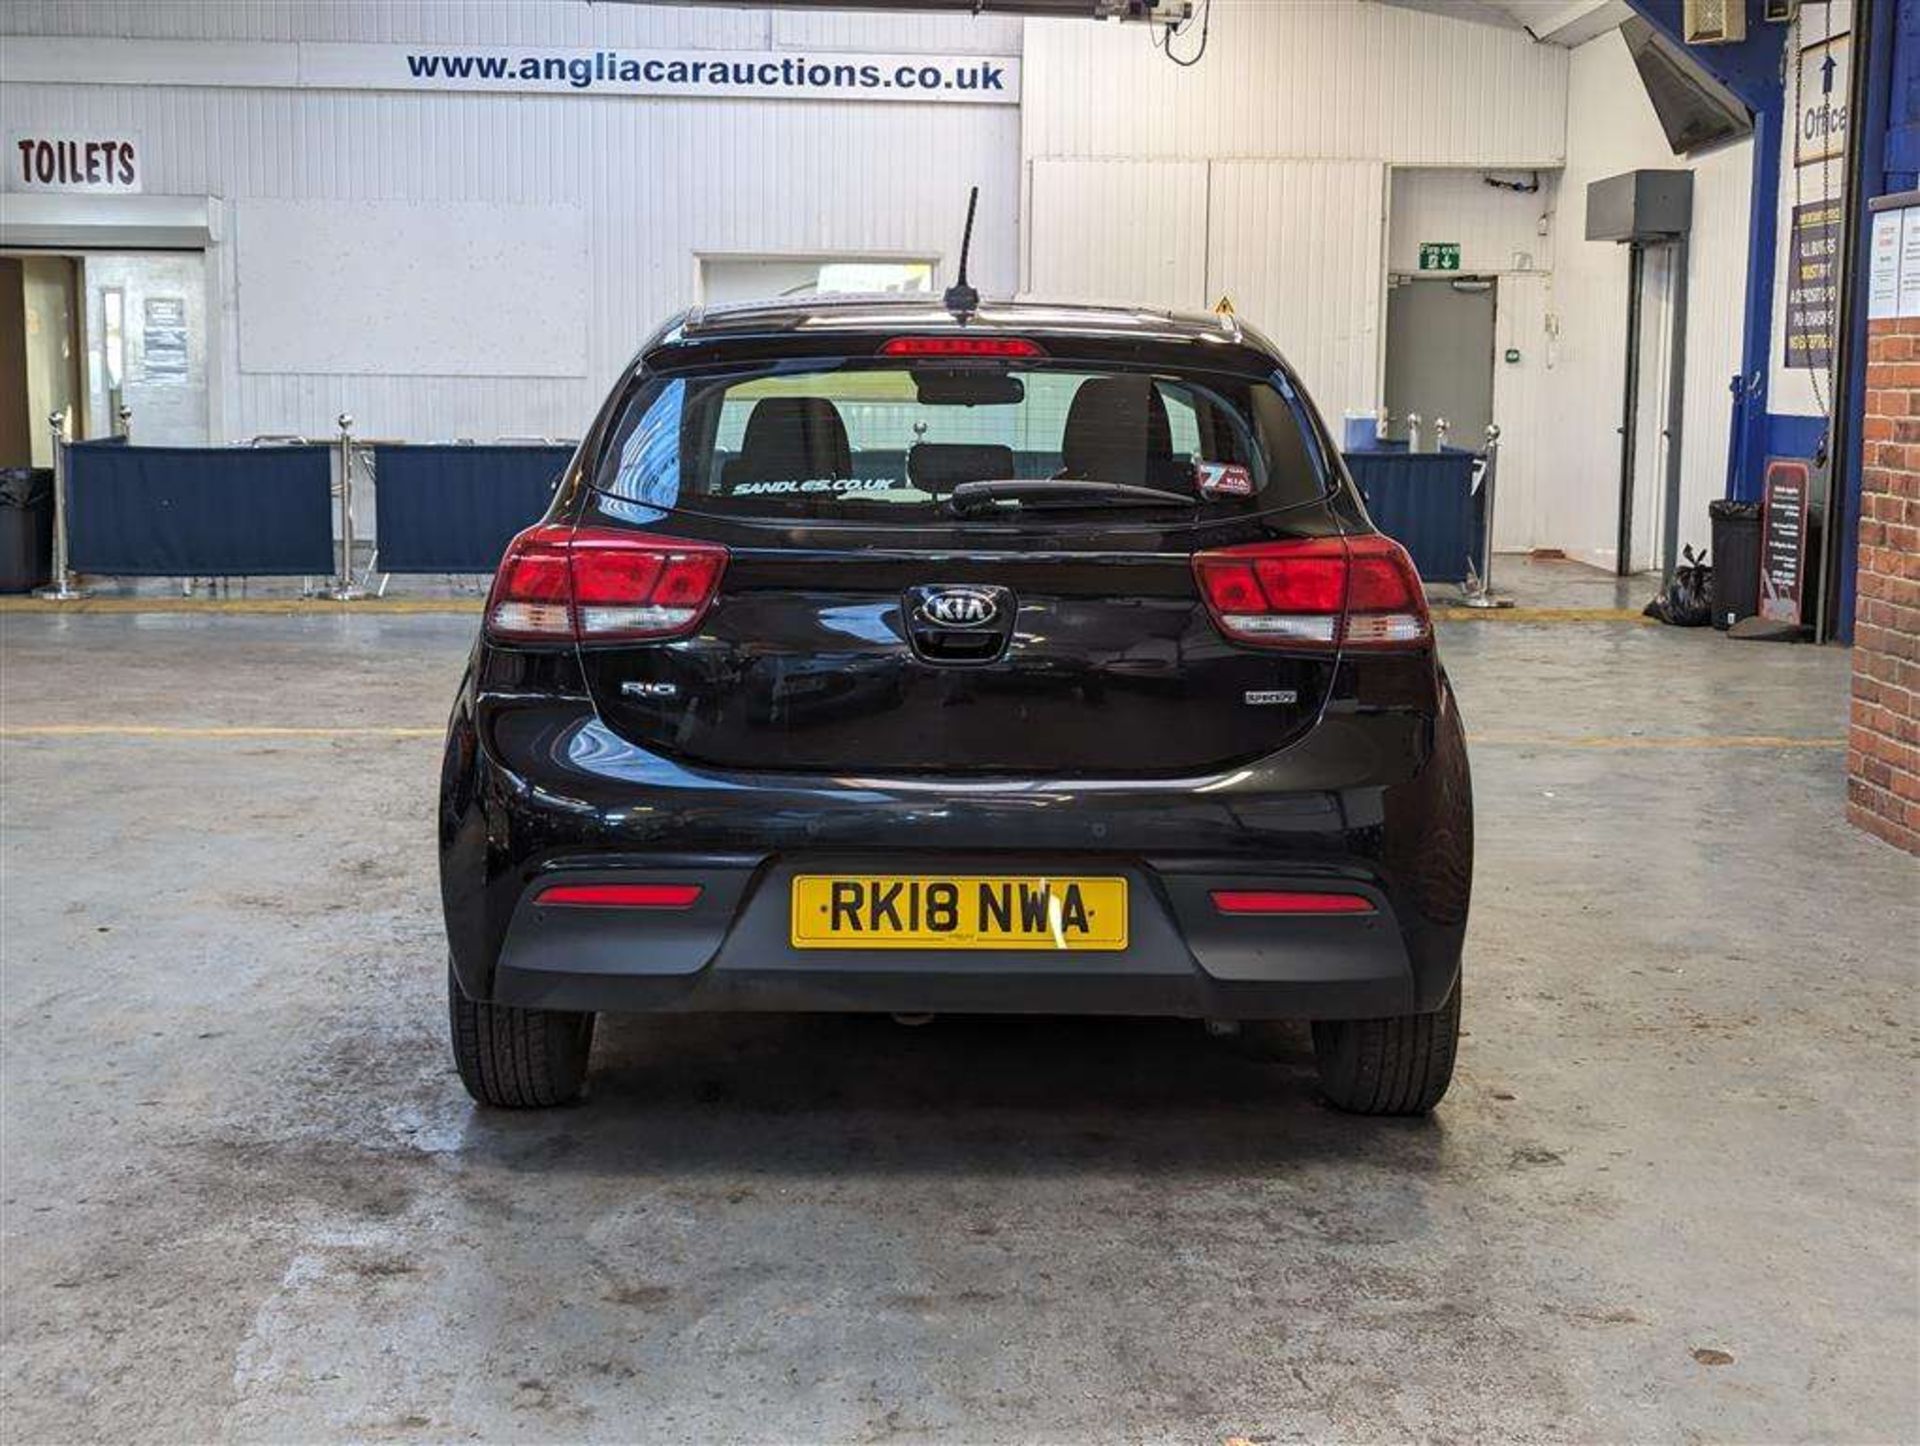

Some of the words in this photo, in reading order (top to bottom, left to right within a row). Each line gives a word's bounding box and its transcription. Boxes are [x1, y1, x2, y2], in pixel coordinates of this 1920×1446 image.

[407, 51, 1004, 90] www.angliacarauctions.co.uk
[1804, 106, 1848, 140] Offce
[18, 139, 135, 185] TOILETS
[935, 598, 985, 619] KIA
[621, 681, 676, 697] RIO
[830, 881, 959, 932] RK18
[978, 883, 1090, 933] NWA
